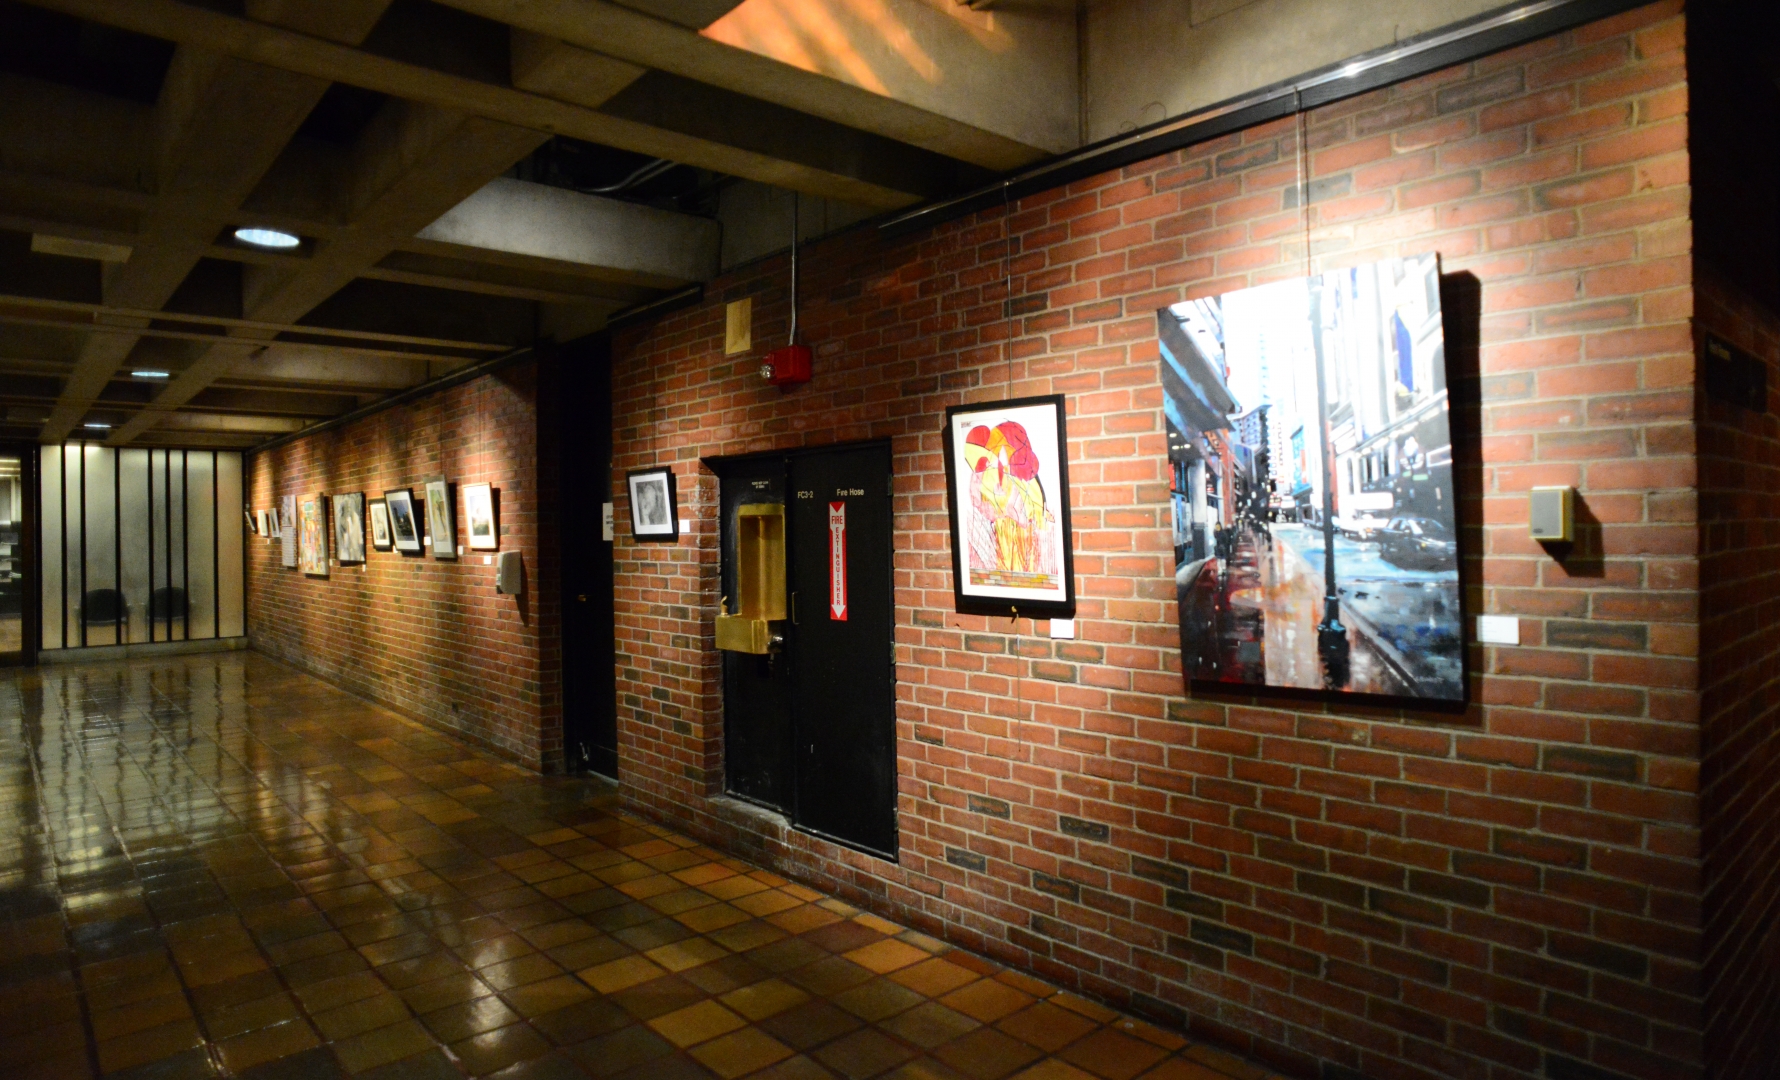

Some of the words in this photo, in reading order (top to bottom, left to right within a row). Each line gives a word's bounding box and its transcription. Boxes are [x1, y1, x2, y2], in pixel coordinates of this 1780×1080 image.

[797, 491, 814, 499] FC3-2
[836, 488, 848, 497] Fire
[849, 488, 865, 496] Hose
[831, 515, 843, 525] FIRE
